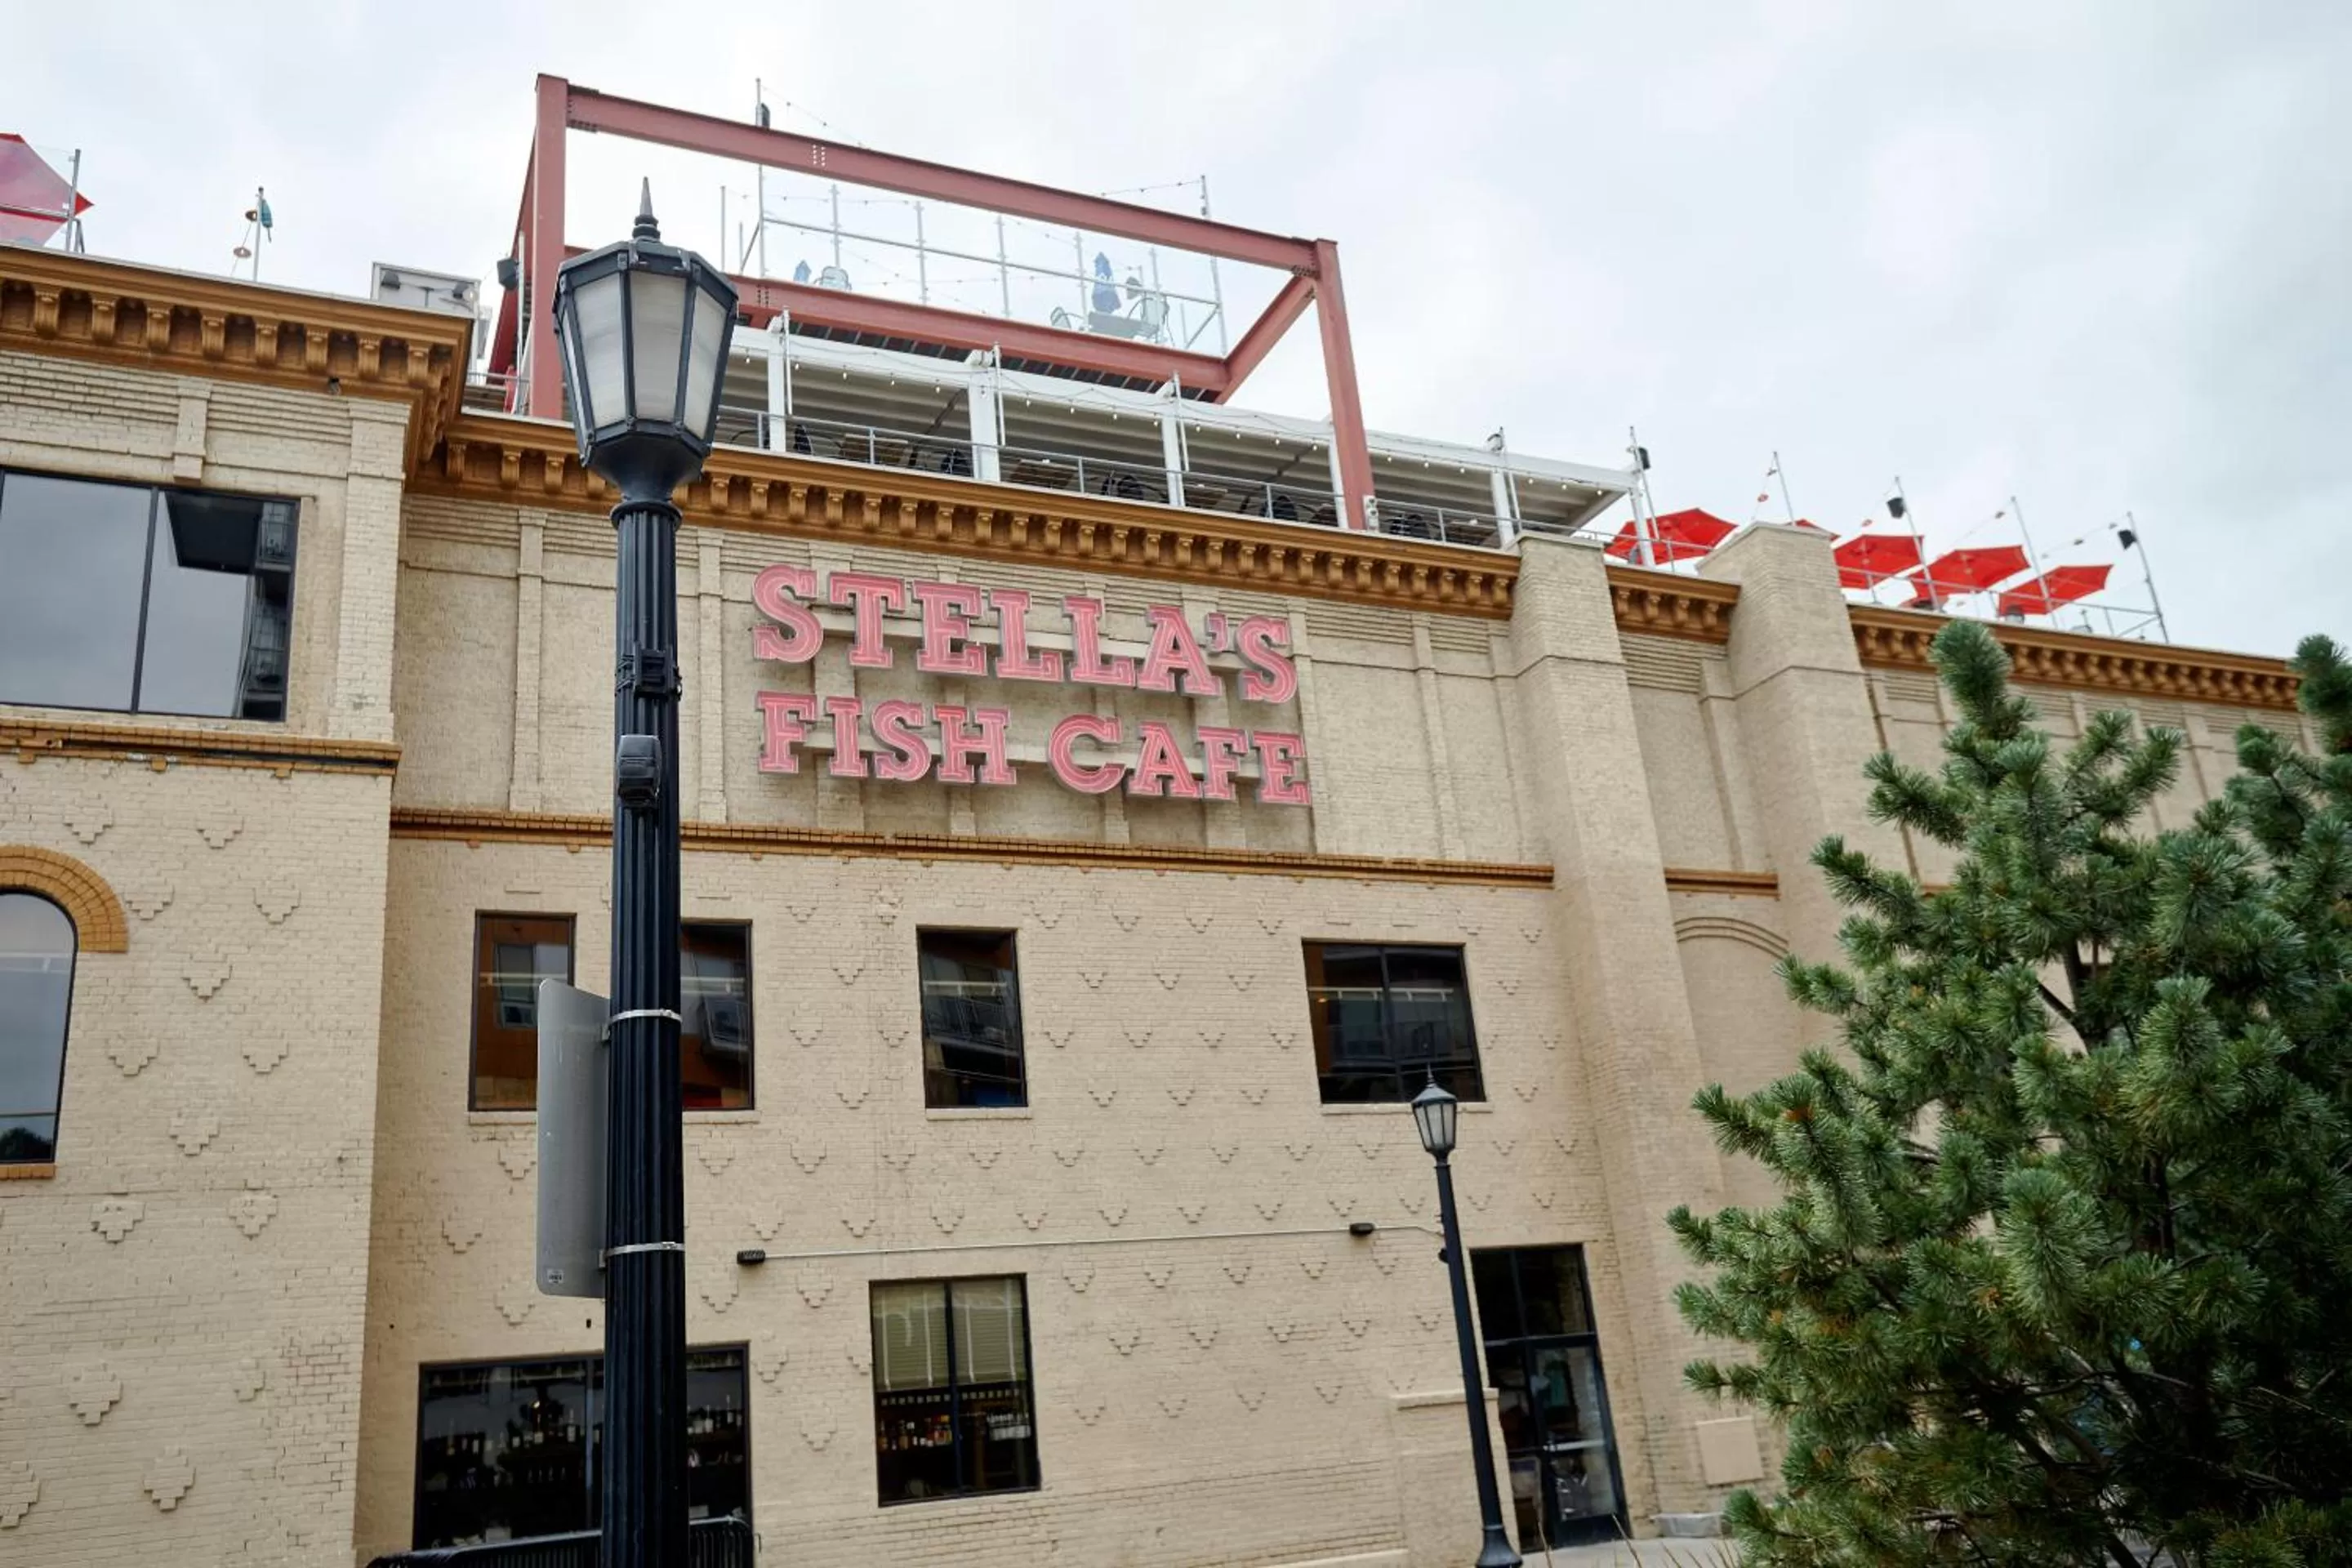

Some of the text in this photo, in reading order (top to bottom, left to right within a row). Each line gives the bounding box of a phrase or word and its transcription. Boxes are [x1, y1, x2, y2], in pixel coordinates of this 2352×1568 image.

[753, 564, 1297, 703] STELLA'S
[757, 690, 1310, 804] FISH CAFE
